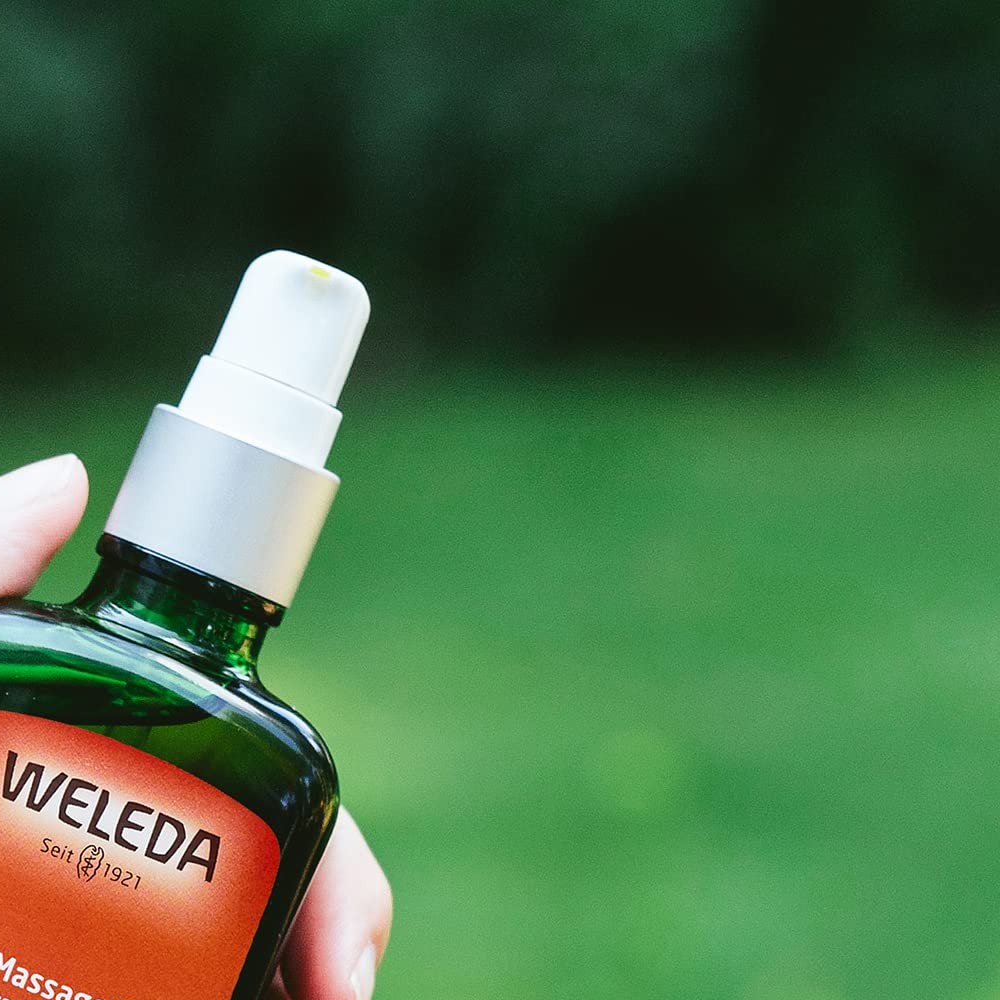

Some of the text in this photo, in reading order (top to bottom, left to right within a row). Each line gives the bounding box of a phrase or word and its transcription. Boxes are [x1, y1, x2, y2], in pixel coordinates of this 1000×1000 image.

[2, 750, 221, 882] WELEDA
[40, 838, 142, 890] Seit 1921
